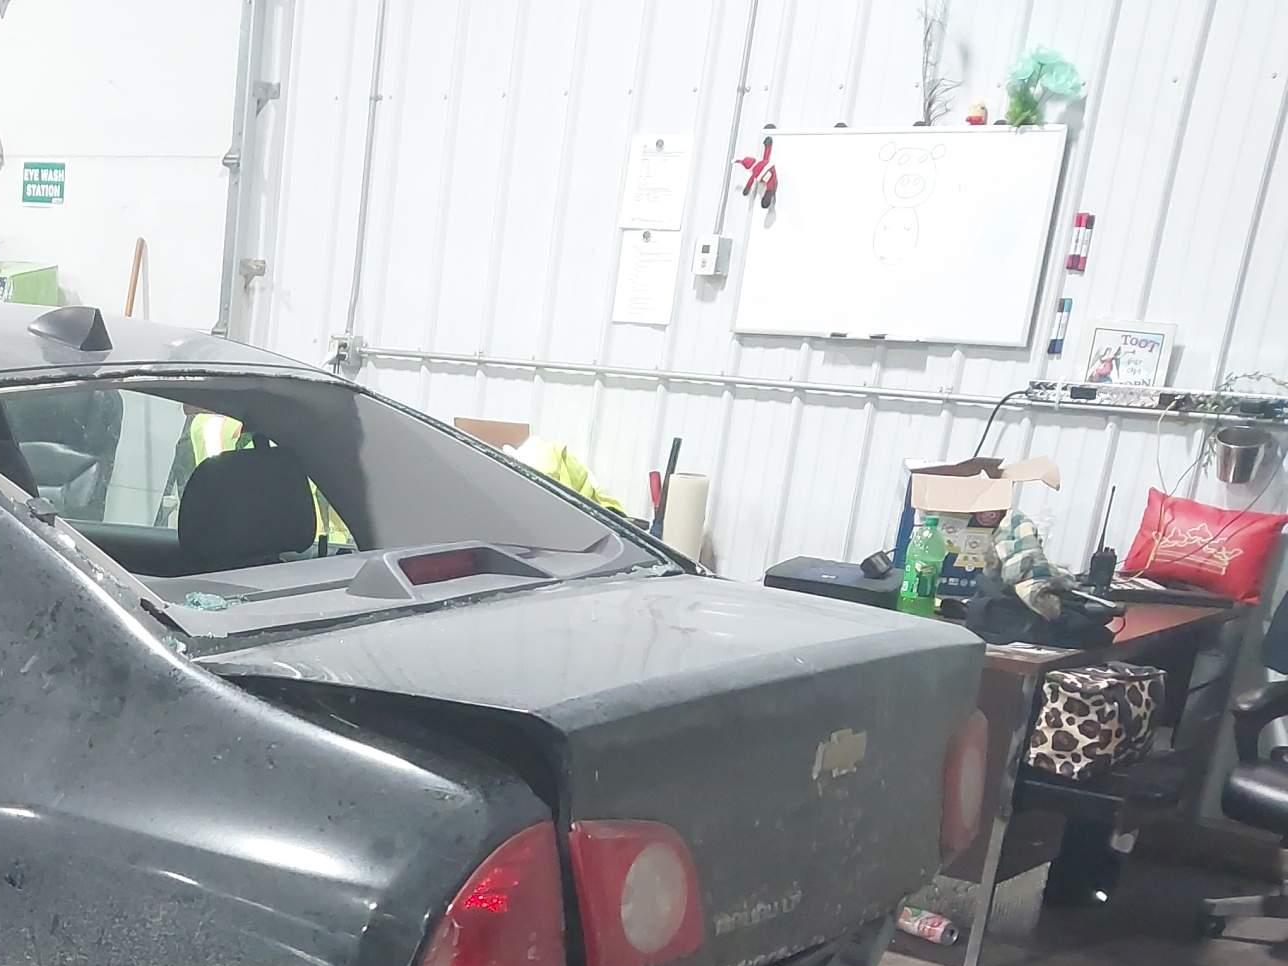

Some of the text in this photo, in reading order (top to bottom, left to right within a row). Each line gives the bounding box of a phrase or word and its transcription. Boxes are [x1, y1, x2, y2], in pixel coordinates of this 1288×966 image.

[24, 168, 65, 182] EYE WASH
[25, 183, 61, 197] STATION
